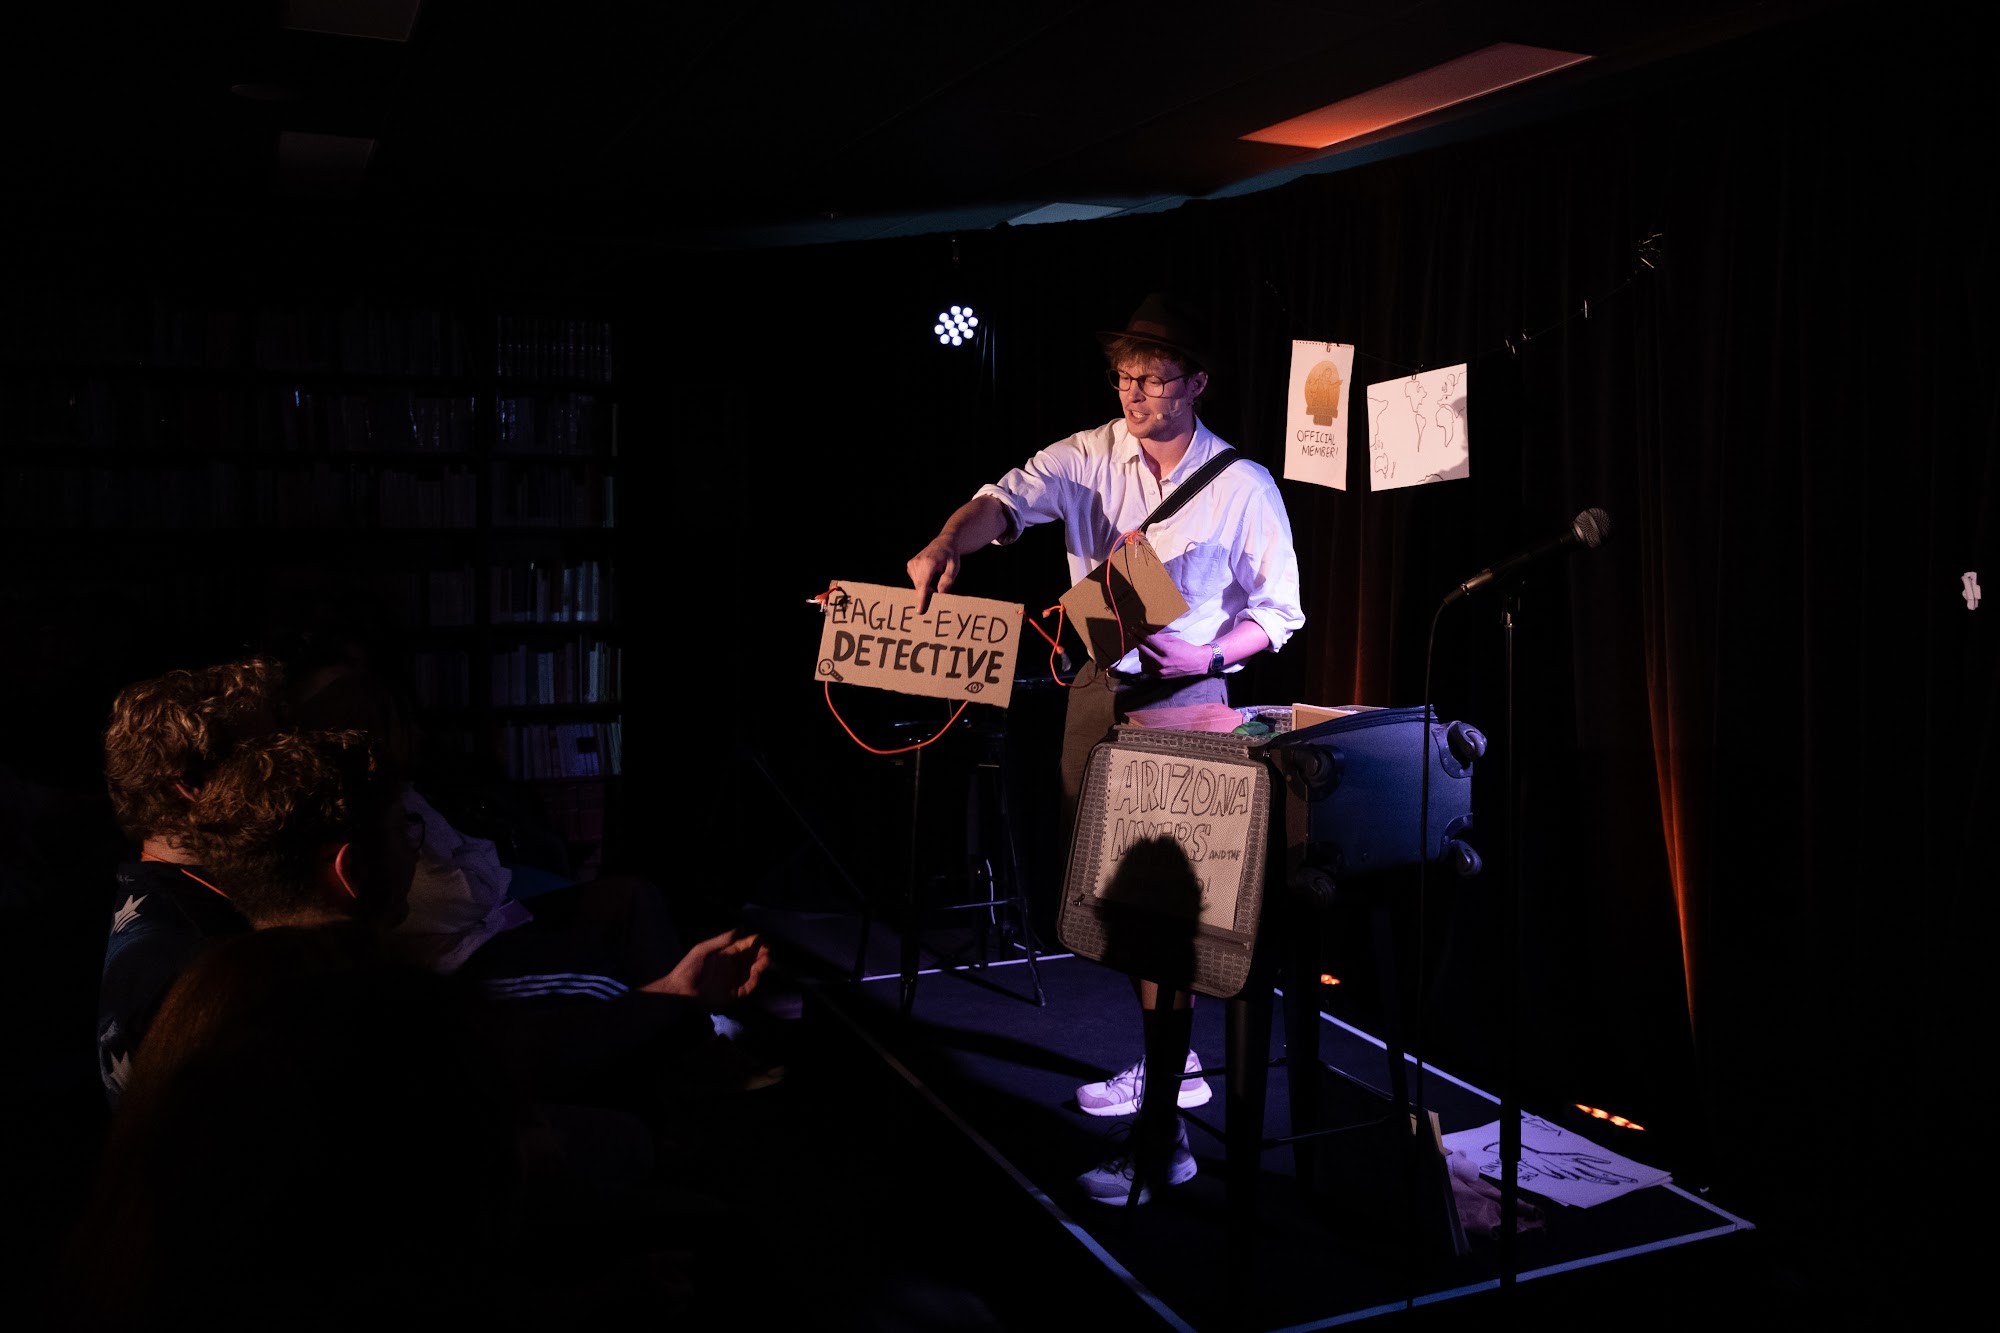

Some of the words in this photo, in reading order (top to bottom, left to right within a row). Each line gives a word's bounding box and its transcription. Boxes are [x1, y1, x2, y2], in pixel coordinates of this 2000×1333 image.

[1297, 429, 1335, 446] OFFICIAL
[1302, 444, 1339, 458] MEMBER!
[832, 595, 1008, 643] EAGLE-EYED
[833, 630, 1004, 684] DETECTIVE
[1114, 760, 1249, 816] ARIZONA
